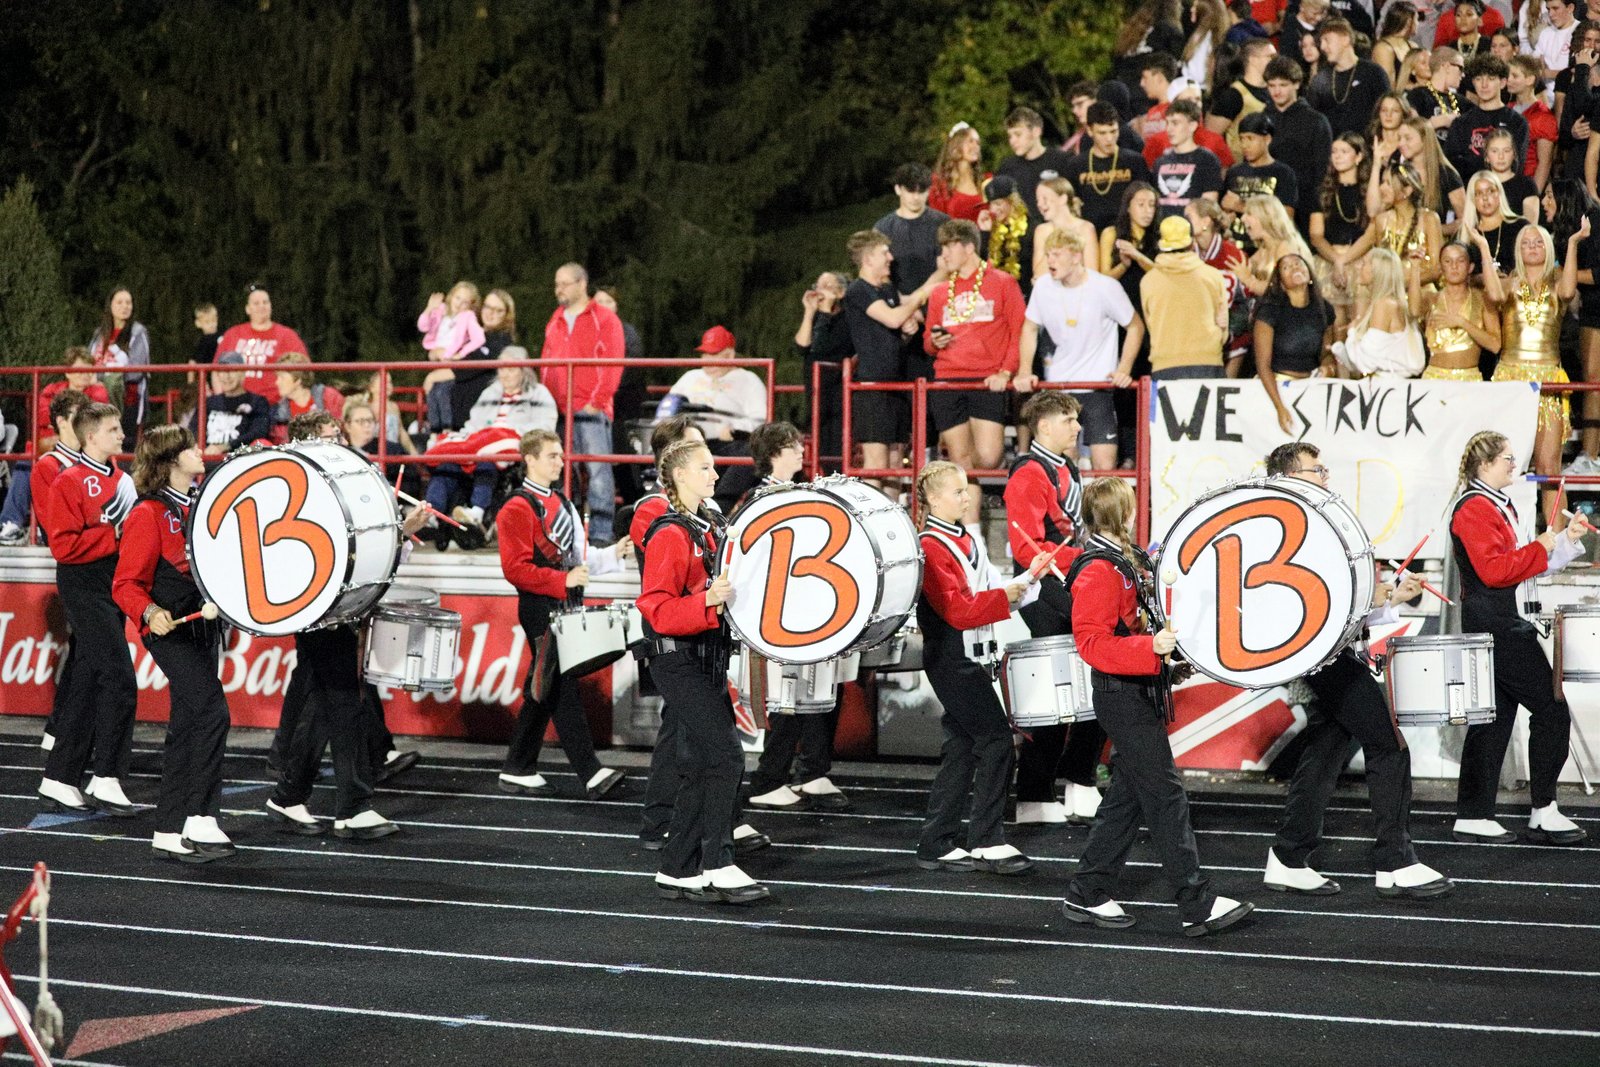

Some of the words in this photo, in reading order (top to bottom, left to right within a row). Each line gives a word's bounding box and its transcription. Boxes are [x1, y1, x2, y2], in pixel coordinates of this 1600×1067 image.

[83, 475, 102, 497] B
[1157, 384, 1243, 443] WE
[206, 457, 336, 625] B
[740, 500, 860, 648] B
[1177, 496, 1331, 672] B
